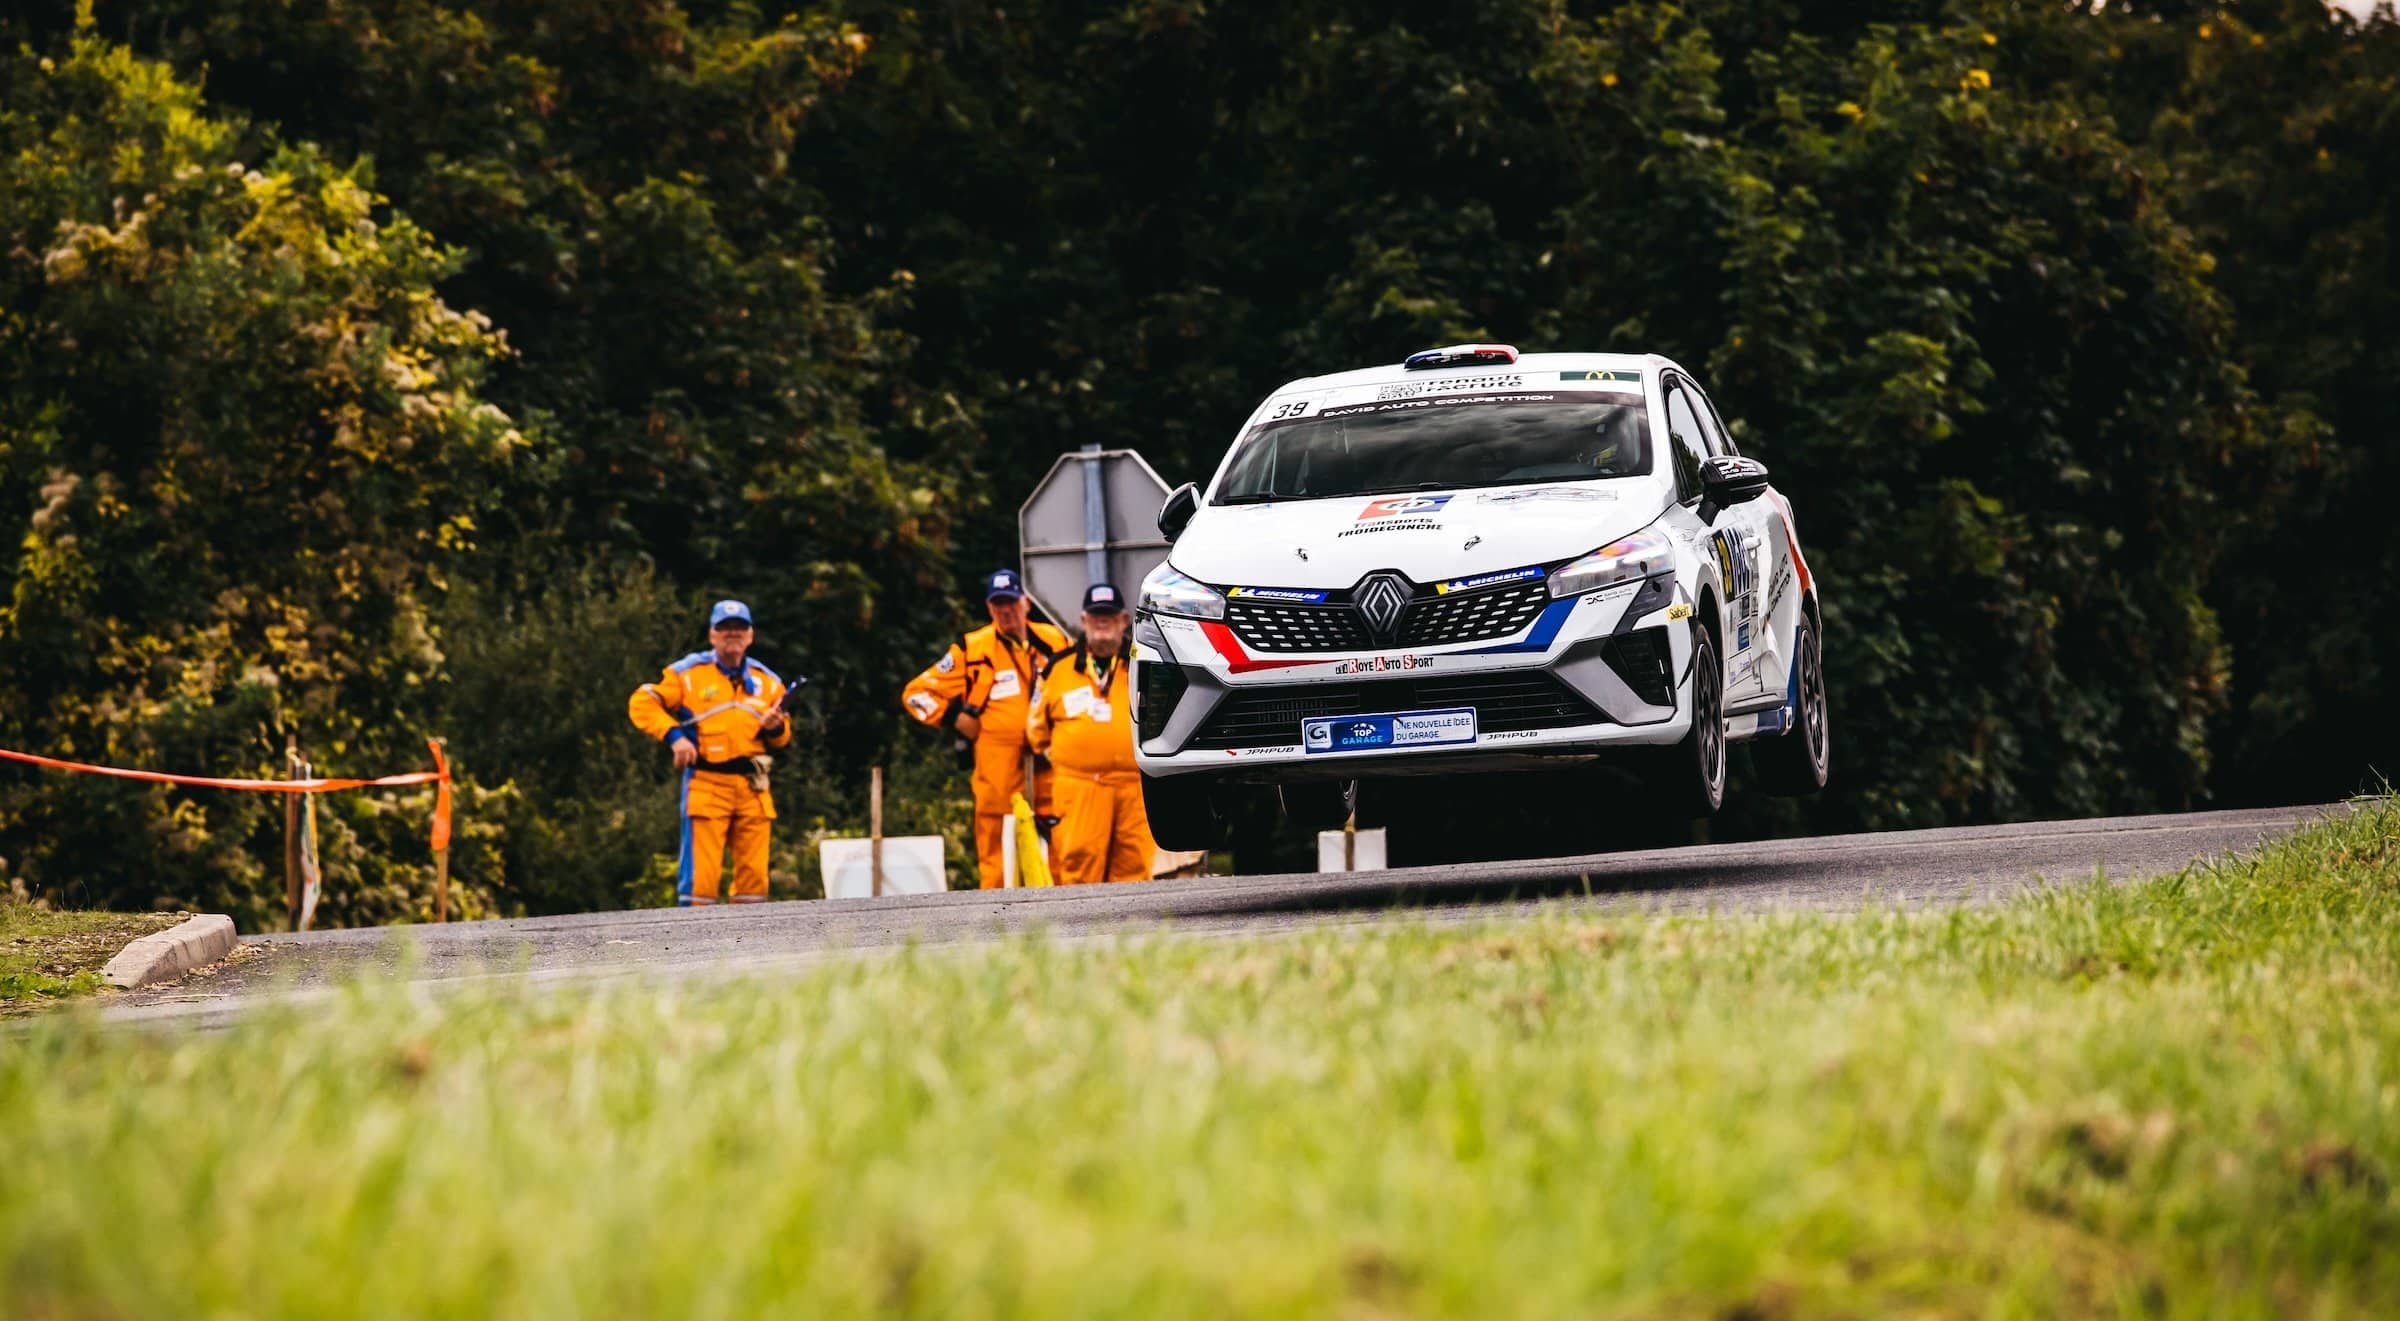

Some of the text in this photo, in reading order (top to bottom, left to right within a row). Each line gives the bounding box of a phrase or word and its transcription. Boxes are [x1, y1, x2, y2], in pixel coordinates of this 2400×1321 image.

[1428, 375, 1523, 386] renault
[1272, 402, 1309, 419] 39
[1323, 394, 1554, 417] DAVID AUTO COMPETITION
[1354, 518, 1434, 528] Transports
[1337, 524, 1443, 538] FROIDECONCHE
[1468, 569, 1535, 586] MICHELIN
[1255, 590, 1320, 599] MICHELIN
[1349, 659, 1374, 673] ROYE
[1376, 657, 1401, 671] AUTO
[1404, 655, 1434, 669] SPORT
[1412, 719, 1452, 729] NOUVELLE
[1342, 735, 1383, 745] GARAGE
[1396, 731, 1440, 741] DU GARAGE
[1487, 731, 1538, 740] JPHPUB
[1246, 747, 1295, 755] JPHPUB
